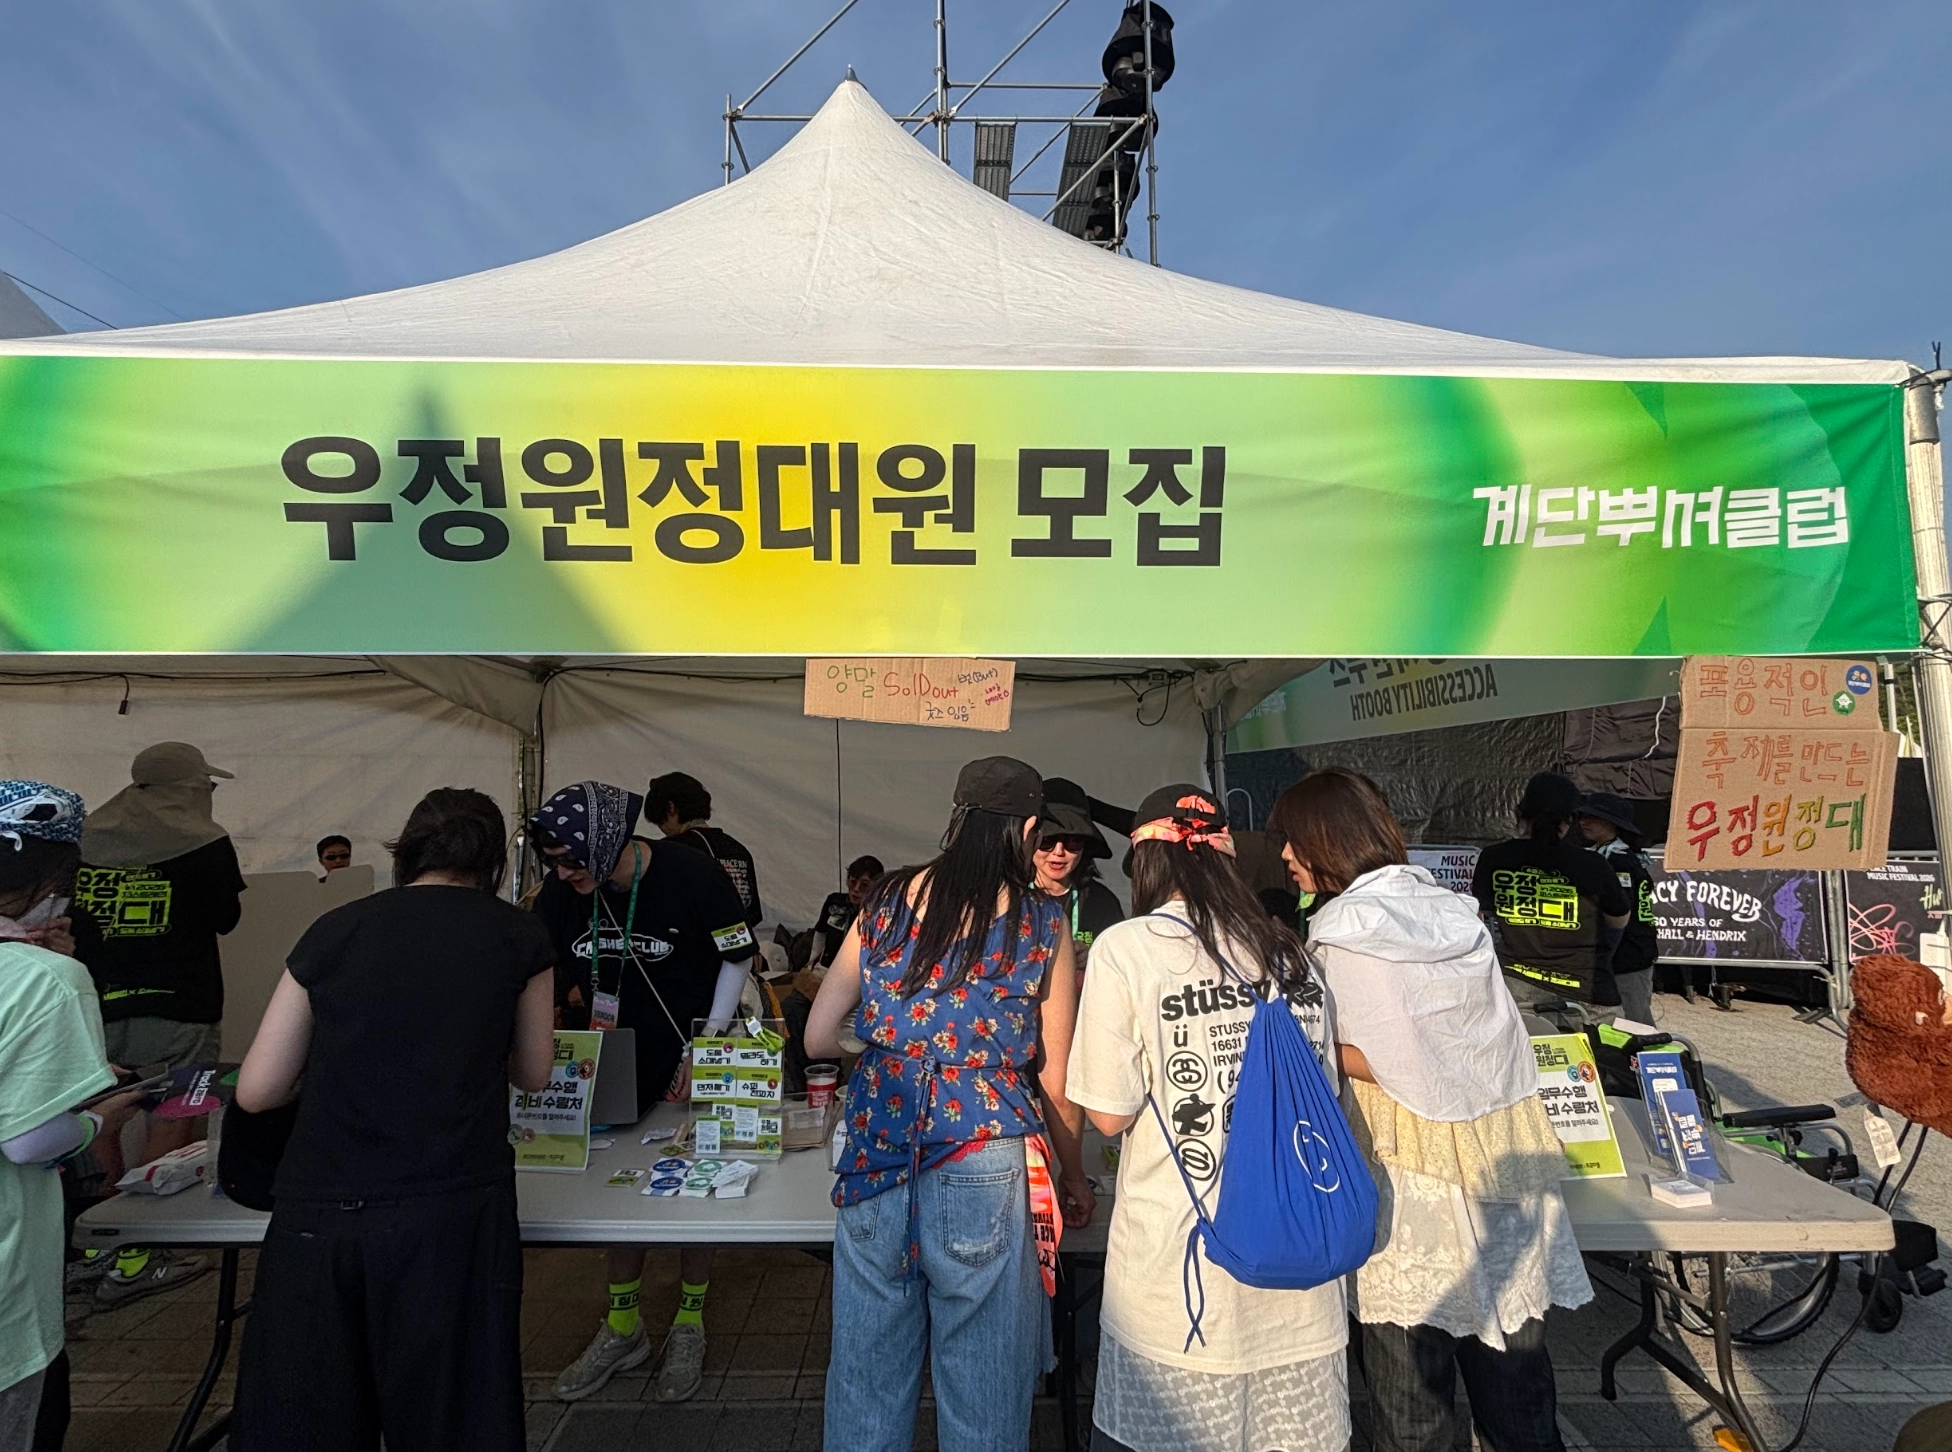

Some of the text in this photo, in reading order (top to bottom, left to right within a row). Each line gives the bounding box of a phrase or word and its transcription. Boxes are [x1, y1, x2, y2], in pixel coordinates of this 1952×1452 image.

[281, 436, 1226, 566] 우정원정대원 모집
[1472, 484, 1849, 549] 계단뿌셔클럽
[826, 664, 876, 698] 양말
[1699, 658, 1830, 718] 포용적인
[1702, 731, 1870, 790] 축제를 만드는
[1687, 792, 1867, 862] 우정원정대
[1441, 855, 1475, 866] MUSIC
[1866, 872, 1889, 880] MUSIC
[1889, 873, 1920, 882] FESTIVAL
[1686, 880, 1762, 922] FOREVER
[1670, 917, 1705, 927] YEARS
[1709, 918, 1723, 927] OF
[1686, 931, 1694, 939] &
[1696, 929, 1747, 942] HENDRIX
[1211, 1037, 1242, 1052] 16631
[1533, 1043, 1552, 1055] 우정
[1536, 1054, 1570, 1067] 원정대
[543, 1096, 583, 1110] 수령처
[1561, 1100, 1600, 1116] 수령처
